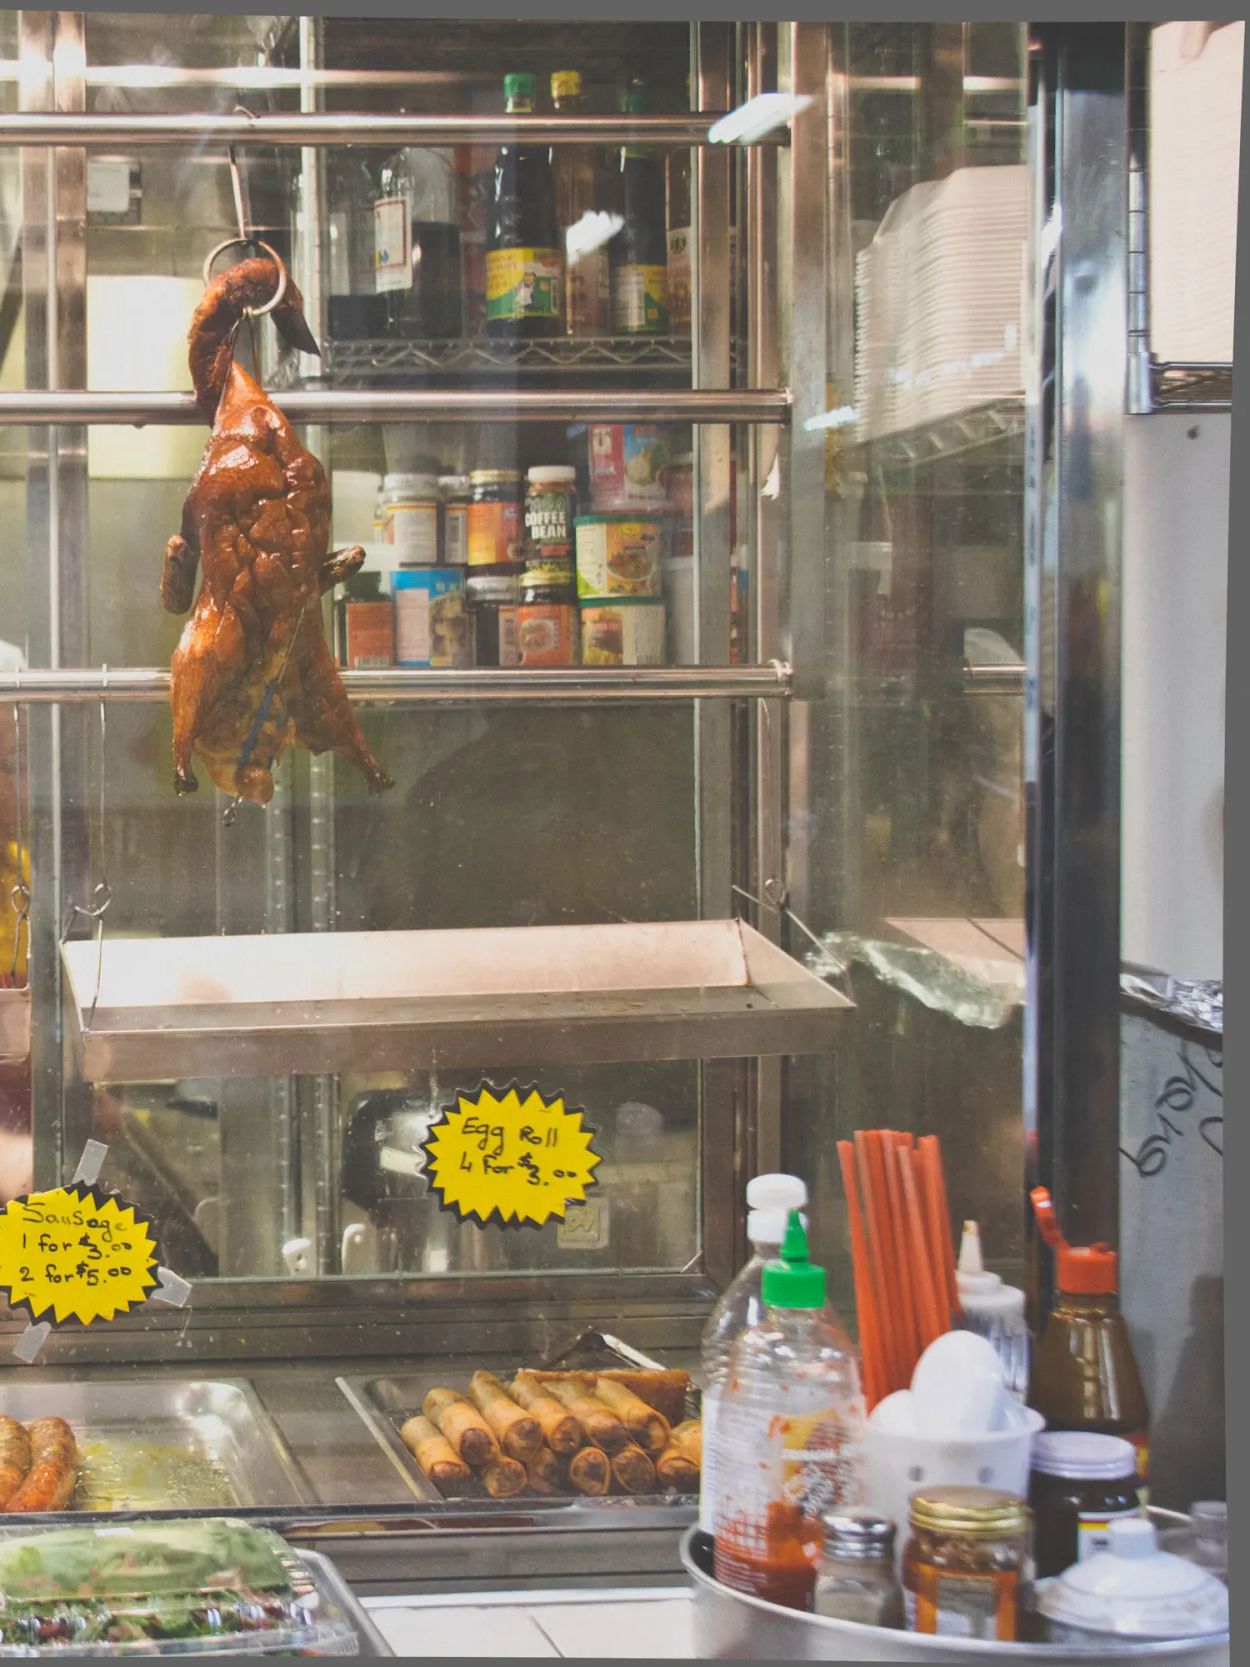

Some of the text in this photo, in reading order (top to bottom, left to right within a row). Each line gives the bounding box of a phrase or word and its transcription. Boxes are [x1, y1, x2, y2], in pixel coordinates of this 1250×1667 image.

[524, 511, 566, 527] COFFEE
[531, 525, 566, 540] BEAN
[461, 1116, 558, 1156] Egg Roll
[459, 1151, 472, 1173] 4
[22, 1232, 132, 1260] 1 for $3.00
[19, 1260, 132, 1286] 2 for $5.00
